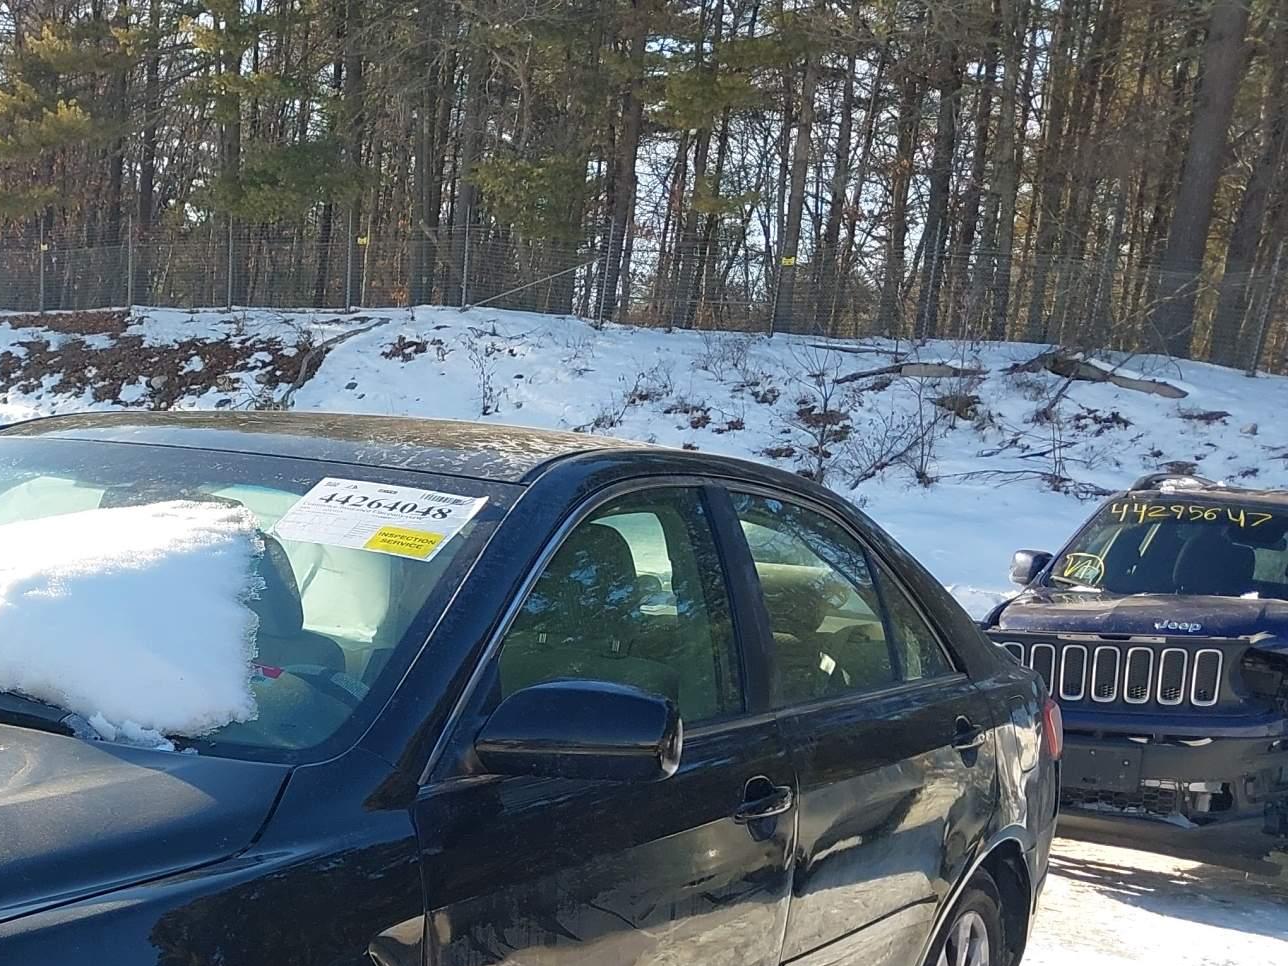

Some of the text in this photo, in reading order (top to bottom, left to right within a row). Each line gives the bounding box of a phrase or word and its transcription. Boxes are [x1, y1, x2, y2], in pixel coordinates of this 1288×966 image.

[318, 492, 453, 520] 44264048
[1111, 503, 1273, 528] 44295647
[378, 531, 437, 545] INSPECTION
[379, 538, 425, 550] SERVICE
[1154, 619, 1202, 633] Jeep
